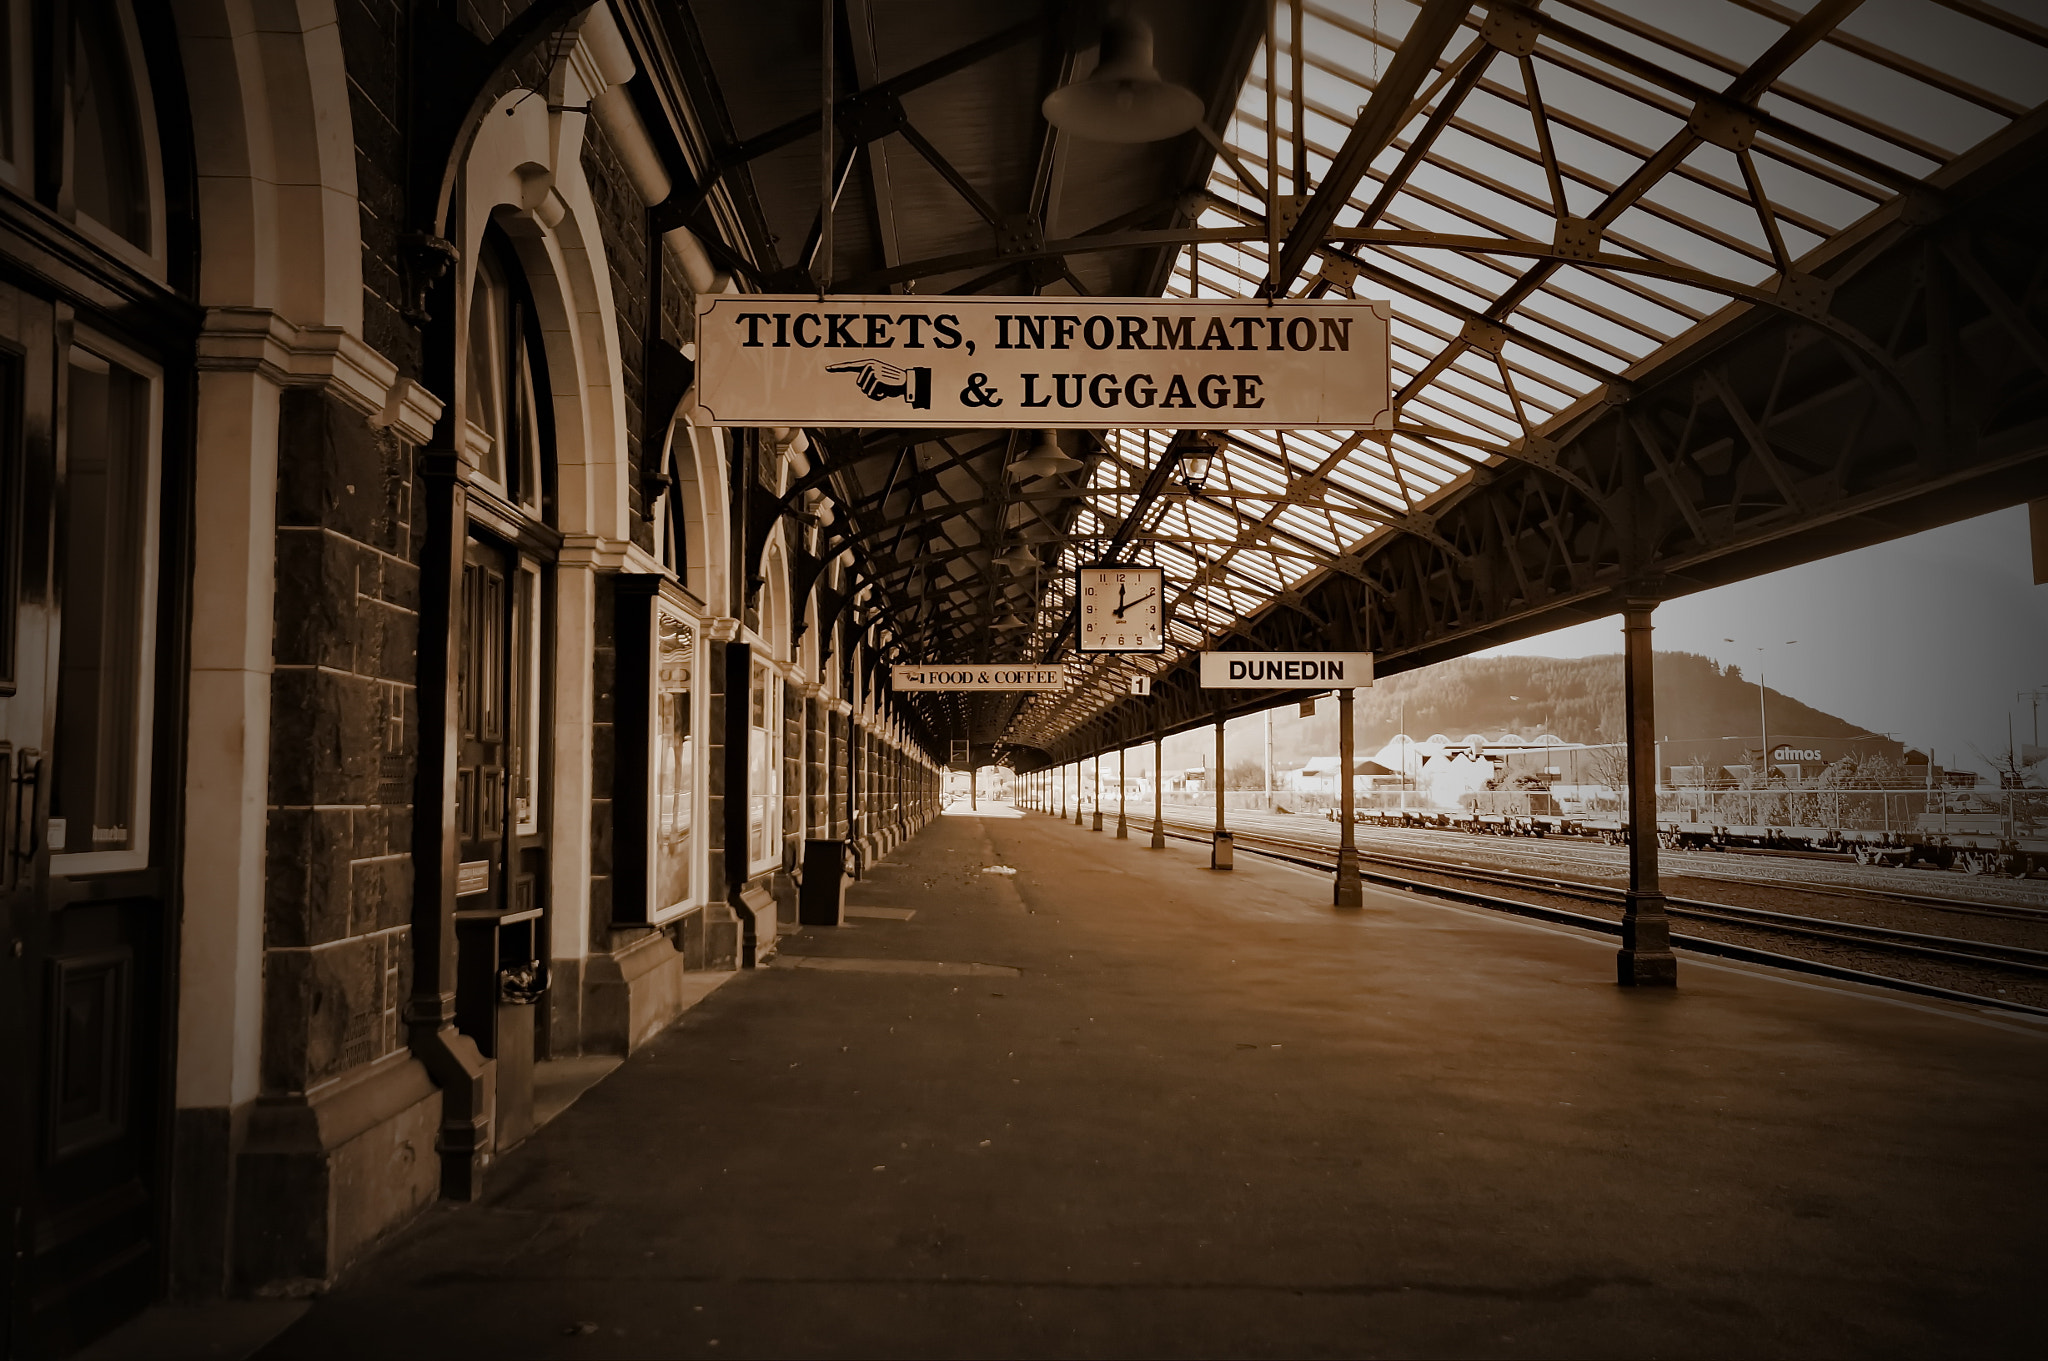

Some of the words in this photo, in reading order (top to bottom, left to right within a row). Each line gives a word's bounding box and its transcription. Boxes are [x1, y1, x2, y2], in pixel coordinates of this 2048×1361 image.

[735, 313, 975, 356] TICKETS,
[995, 315, 1353, 352] INFORMATION
[960, 373, 1003, 408] &
[1021, 374, 1265, 409] LUGGAGE
[1100, 574, 1106, 582] 11
[1117, 574, 1126, 582] 12
[1085, 587, 1094, 596] 10
[1149, 587, 1156, 595] 2
[1086, 605, 1093, 614] 9
[1150, 605, 1156, 614] 3
[1086, 623, 1093, 632] 8
[1149, 624, 1156, 632] 4
[1100, 636, 1107, 645] 7
[1118, 636, 1125, 646] 6
[1136, 636, 1143, 646] 5
[1230, 661, 1343, 681] DUNEDIN
[930, 671, 973, 684] FOOD
[978, 671, 989, 684] &
[995, 671, 1057, 684] COFFEE
[1136, 678, 1143, 693] 1
